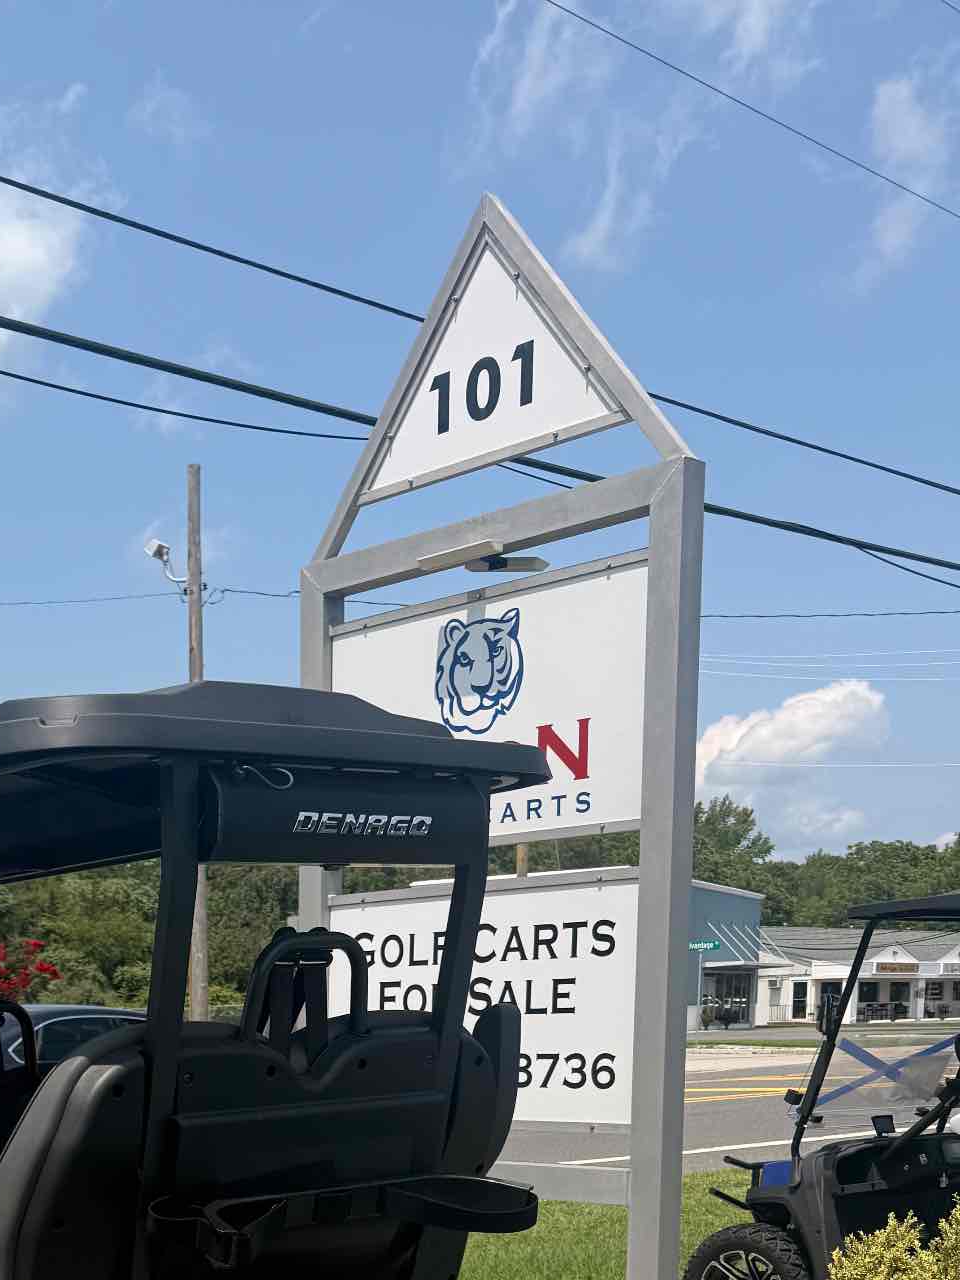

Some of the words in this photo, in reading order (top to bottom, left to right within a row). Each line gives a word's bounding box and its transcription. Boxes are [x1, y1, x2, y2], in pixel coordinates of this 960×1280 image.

[428, 339, 535, 436] 101
[293, 811, 433, 836] DENAGO
[490, 791, 592, 824] ARTS
[472, 919, 617, 964] CARTS
[379, 980, 440, 1012] FO
